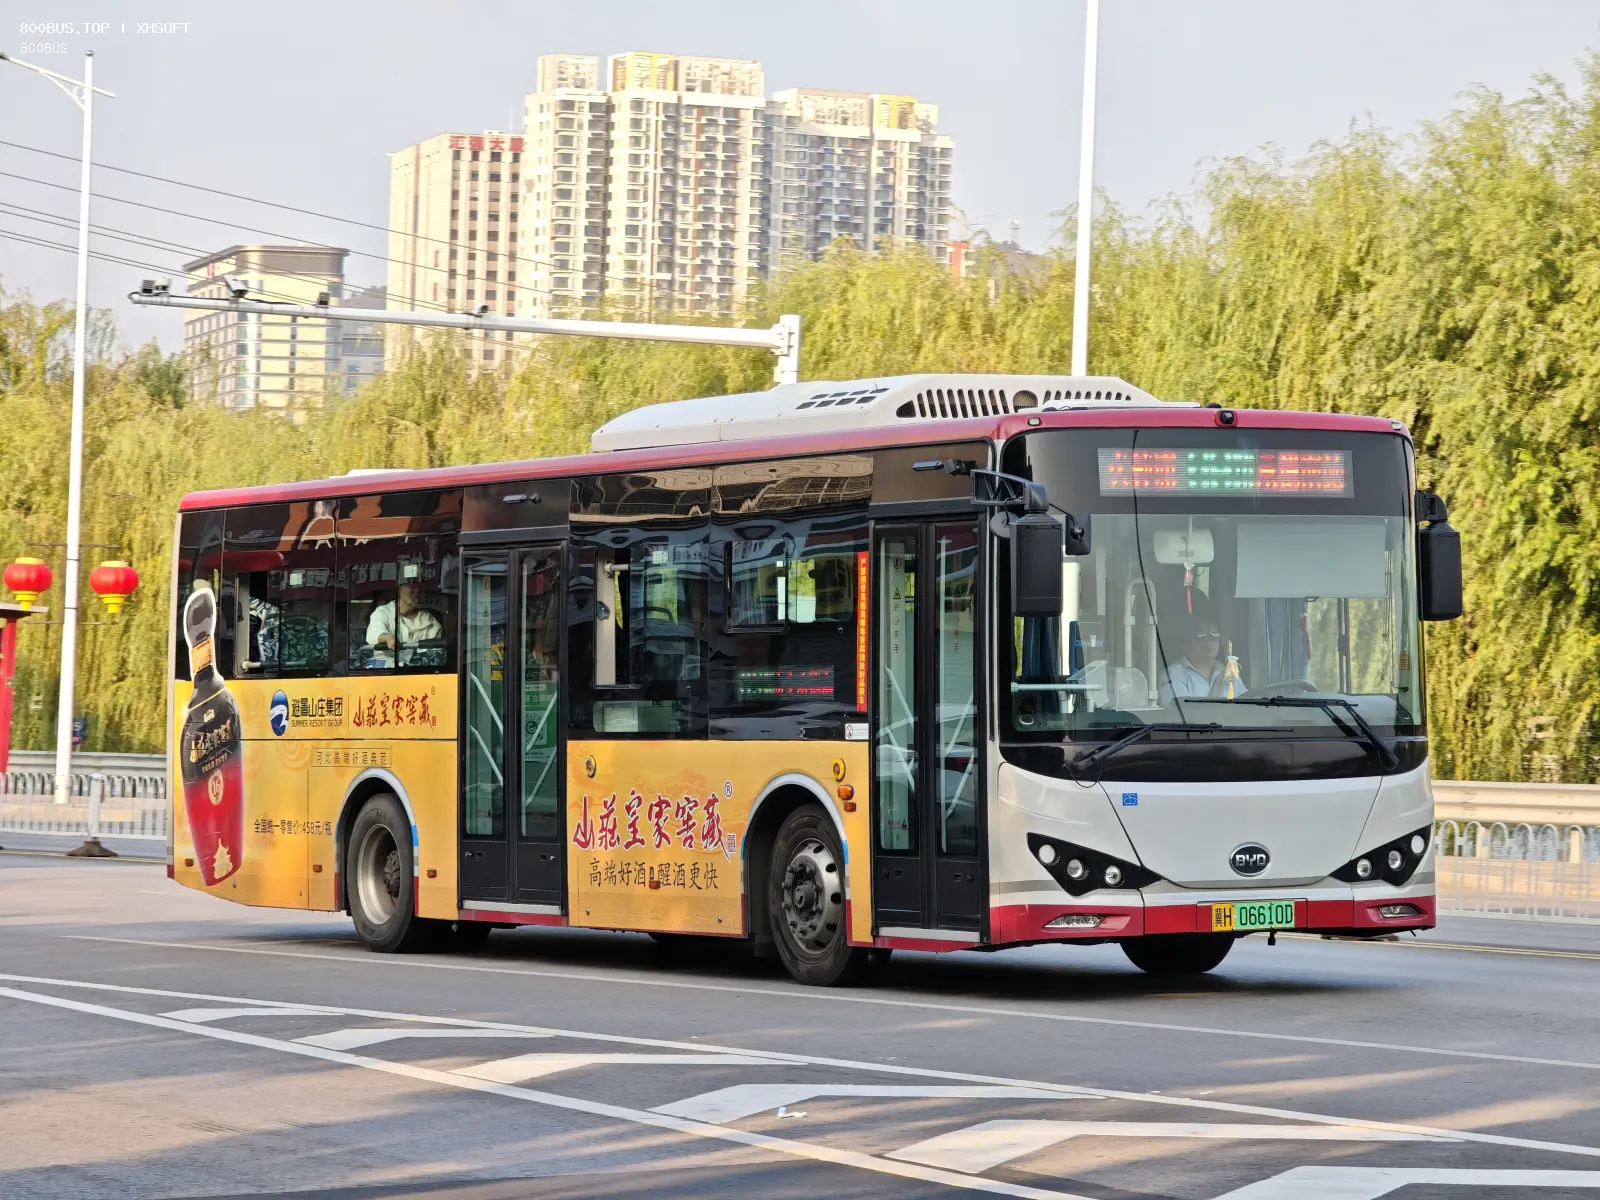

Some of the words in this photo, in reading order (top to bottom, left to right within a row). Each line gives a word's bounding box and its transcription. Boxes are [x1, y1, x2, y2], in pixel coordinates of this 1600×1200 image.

[291, 697, 343, 717] 避暑山庄集团
[291, 719, 308, 728] SUMMER
[309, 719, 327, 728] RESORT
[327, 718, 343, 727] GROUP
[316, 751, 388, 766] 河北高端好酒典范
[1235, 854, 1266, 867] BYD
